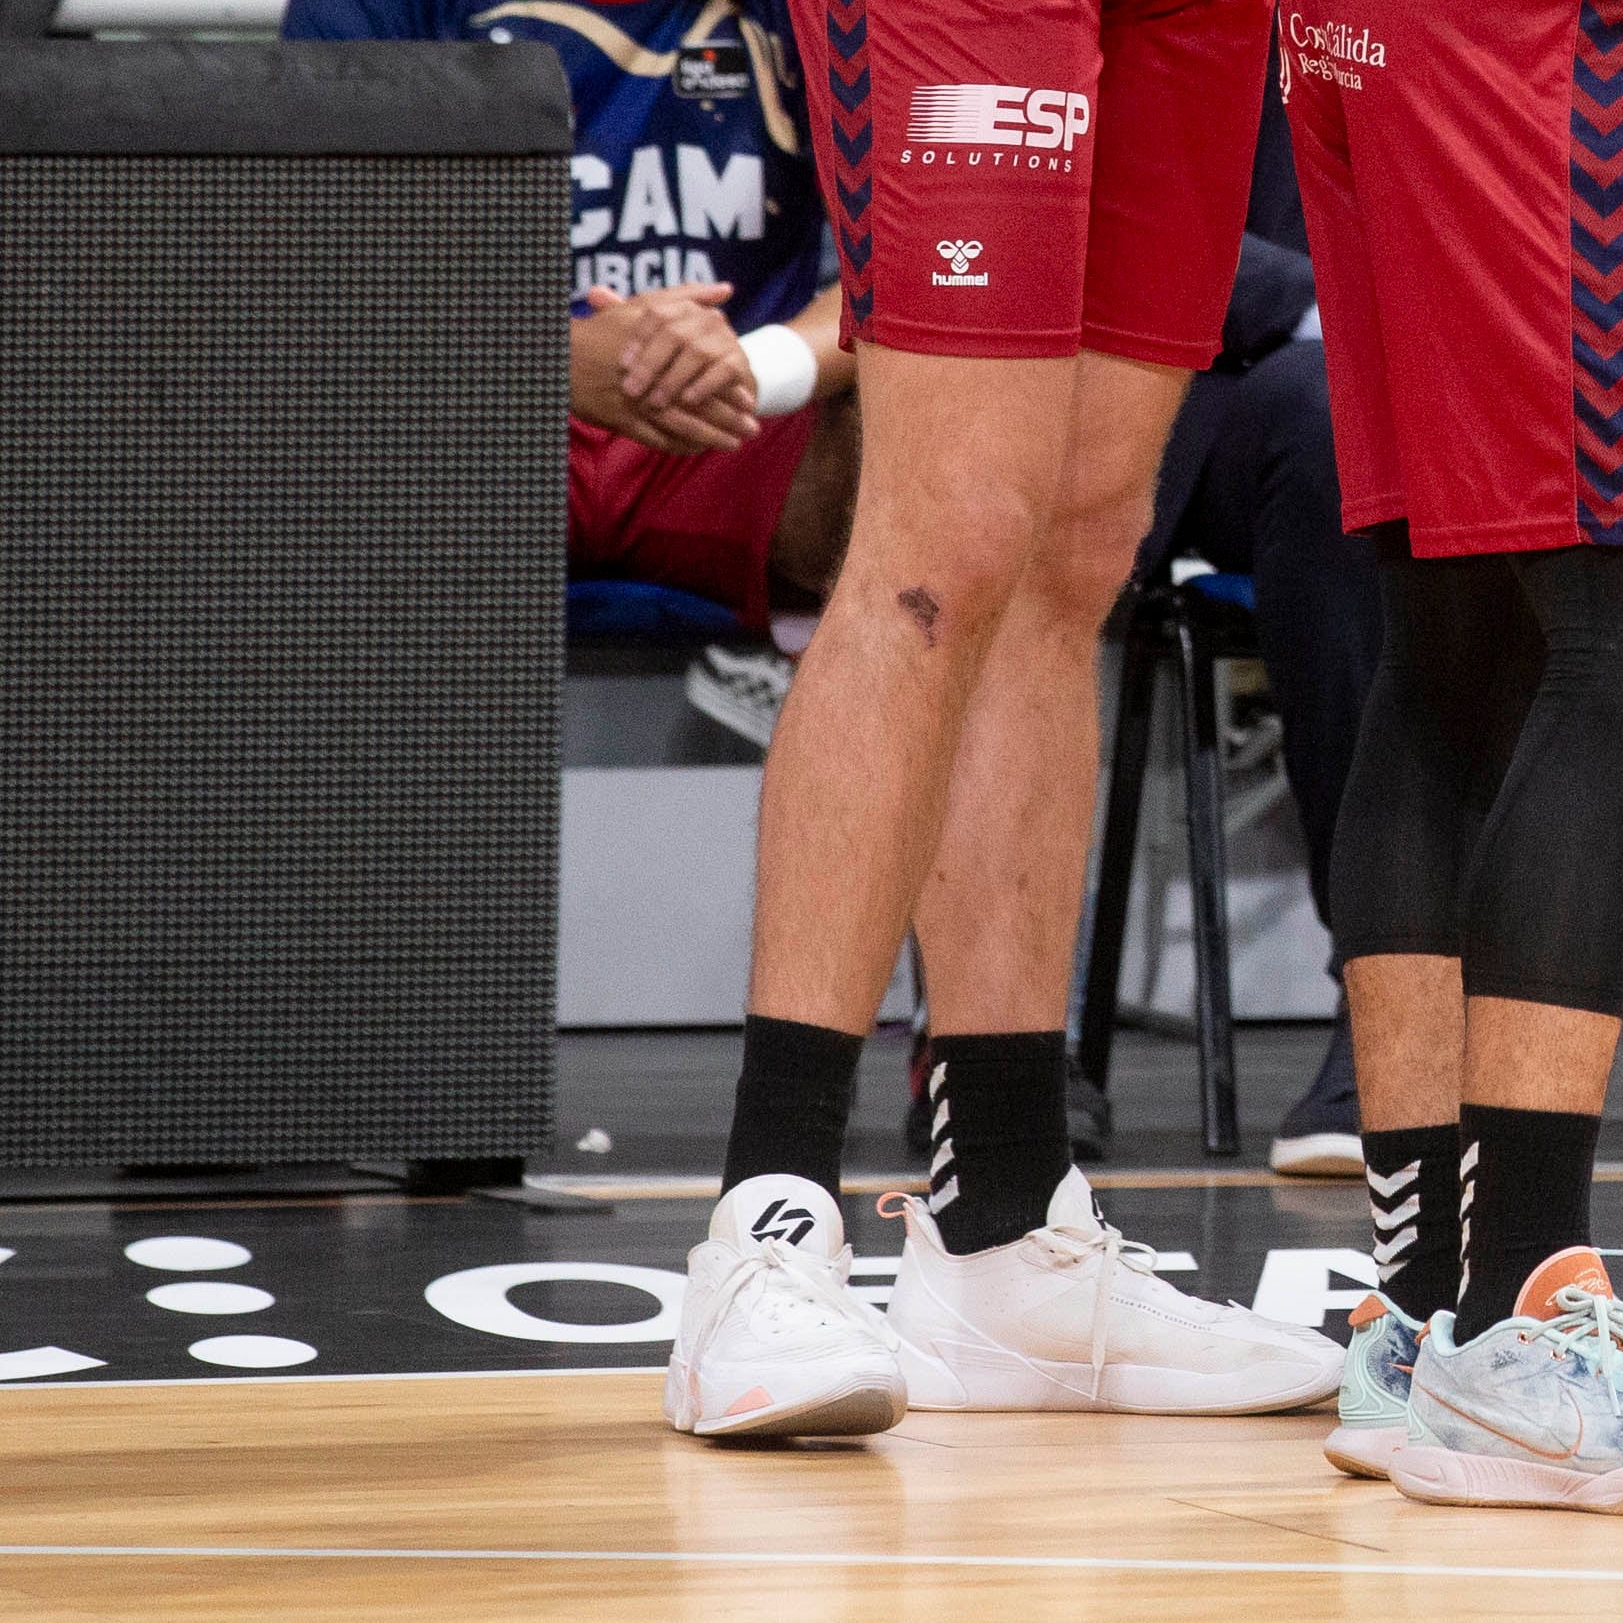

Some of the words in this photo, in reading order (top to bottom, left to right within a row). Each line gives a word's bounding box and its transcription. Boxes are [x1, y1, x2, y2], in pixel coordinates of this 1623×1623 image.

[935, 84, 1090, 152] ESP
[901, 149, 1073, 172] SOLUTIONS
[932, 271, 989, 286] hummel
